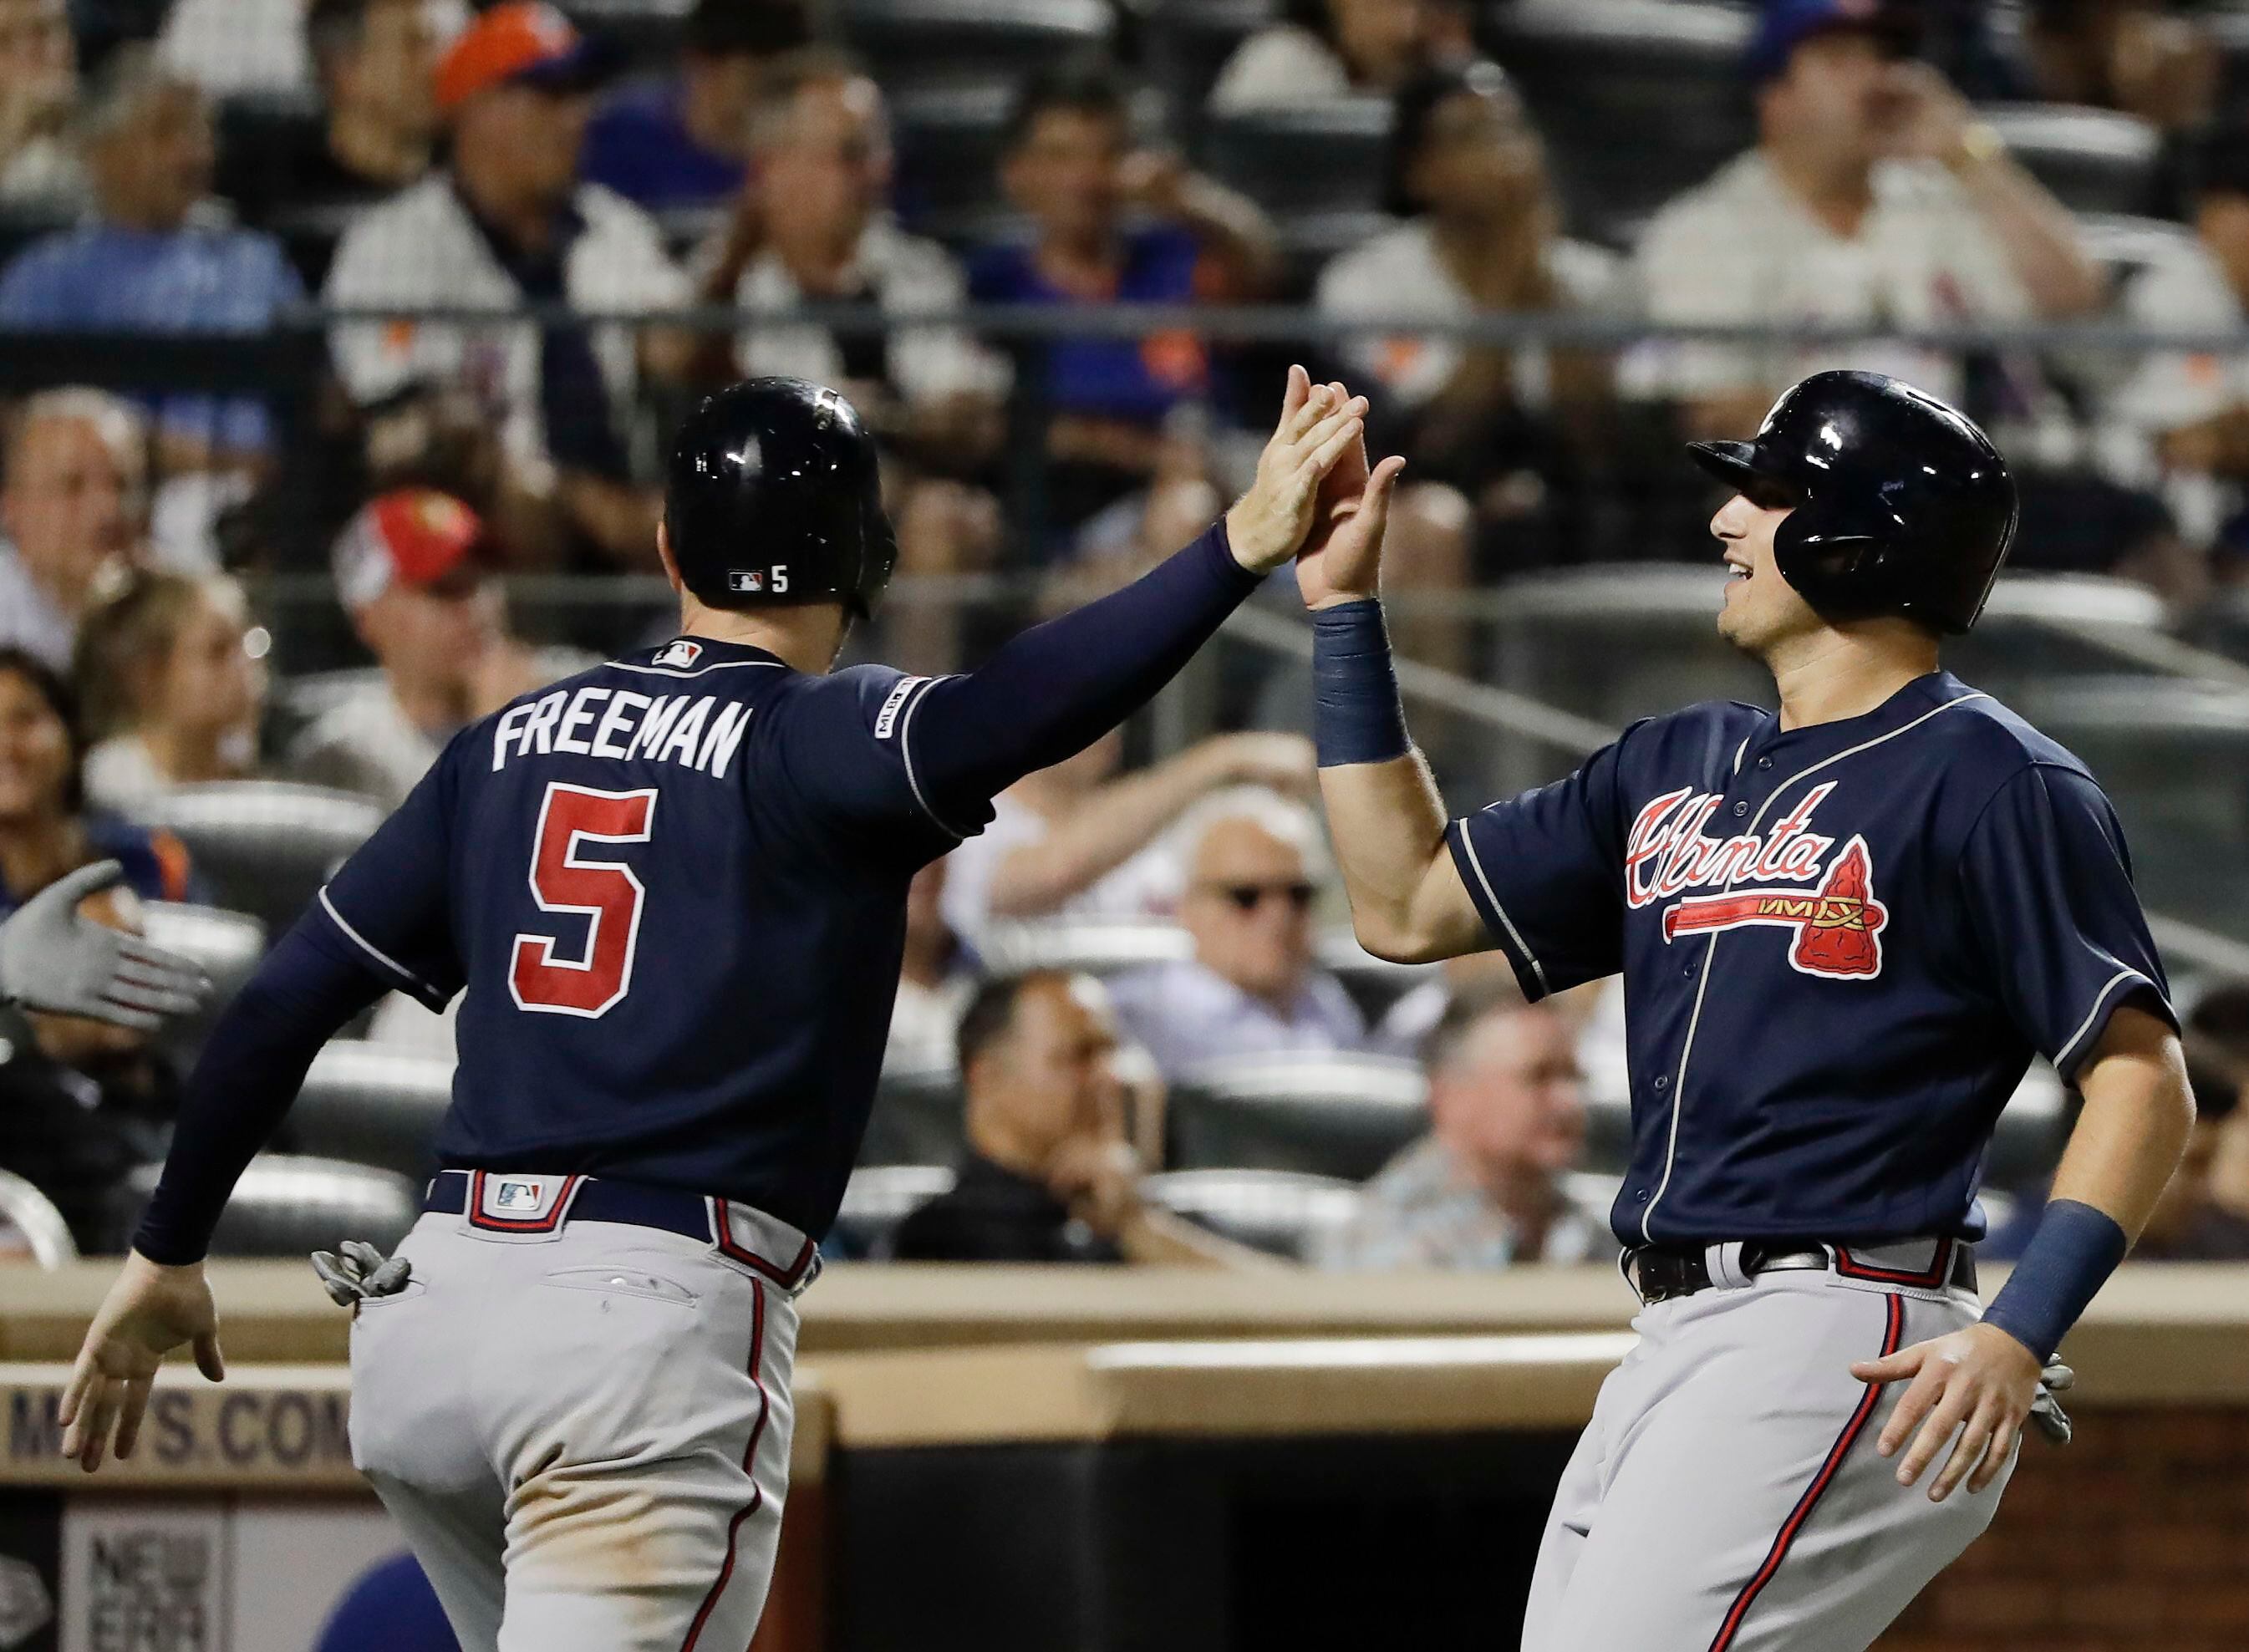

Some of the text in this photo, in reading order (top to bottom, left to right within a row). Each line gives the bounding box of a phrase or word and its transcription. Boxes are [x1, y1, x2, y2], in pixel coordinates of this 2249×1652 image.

[771, 565, 788, 592] 5
[492, 687, 753, 779] FREEMAN
[507, 781, 659, 1018] 5
[1626, 780, 1838, 909] Atlanta
